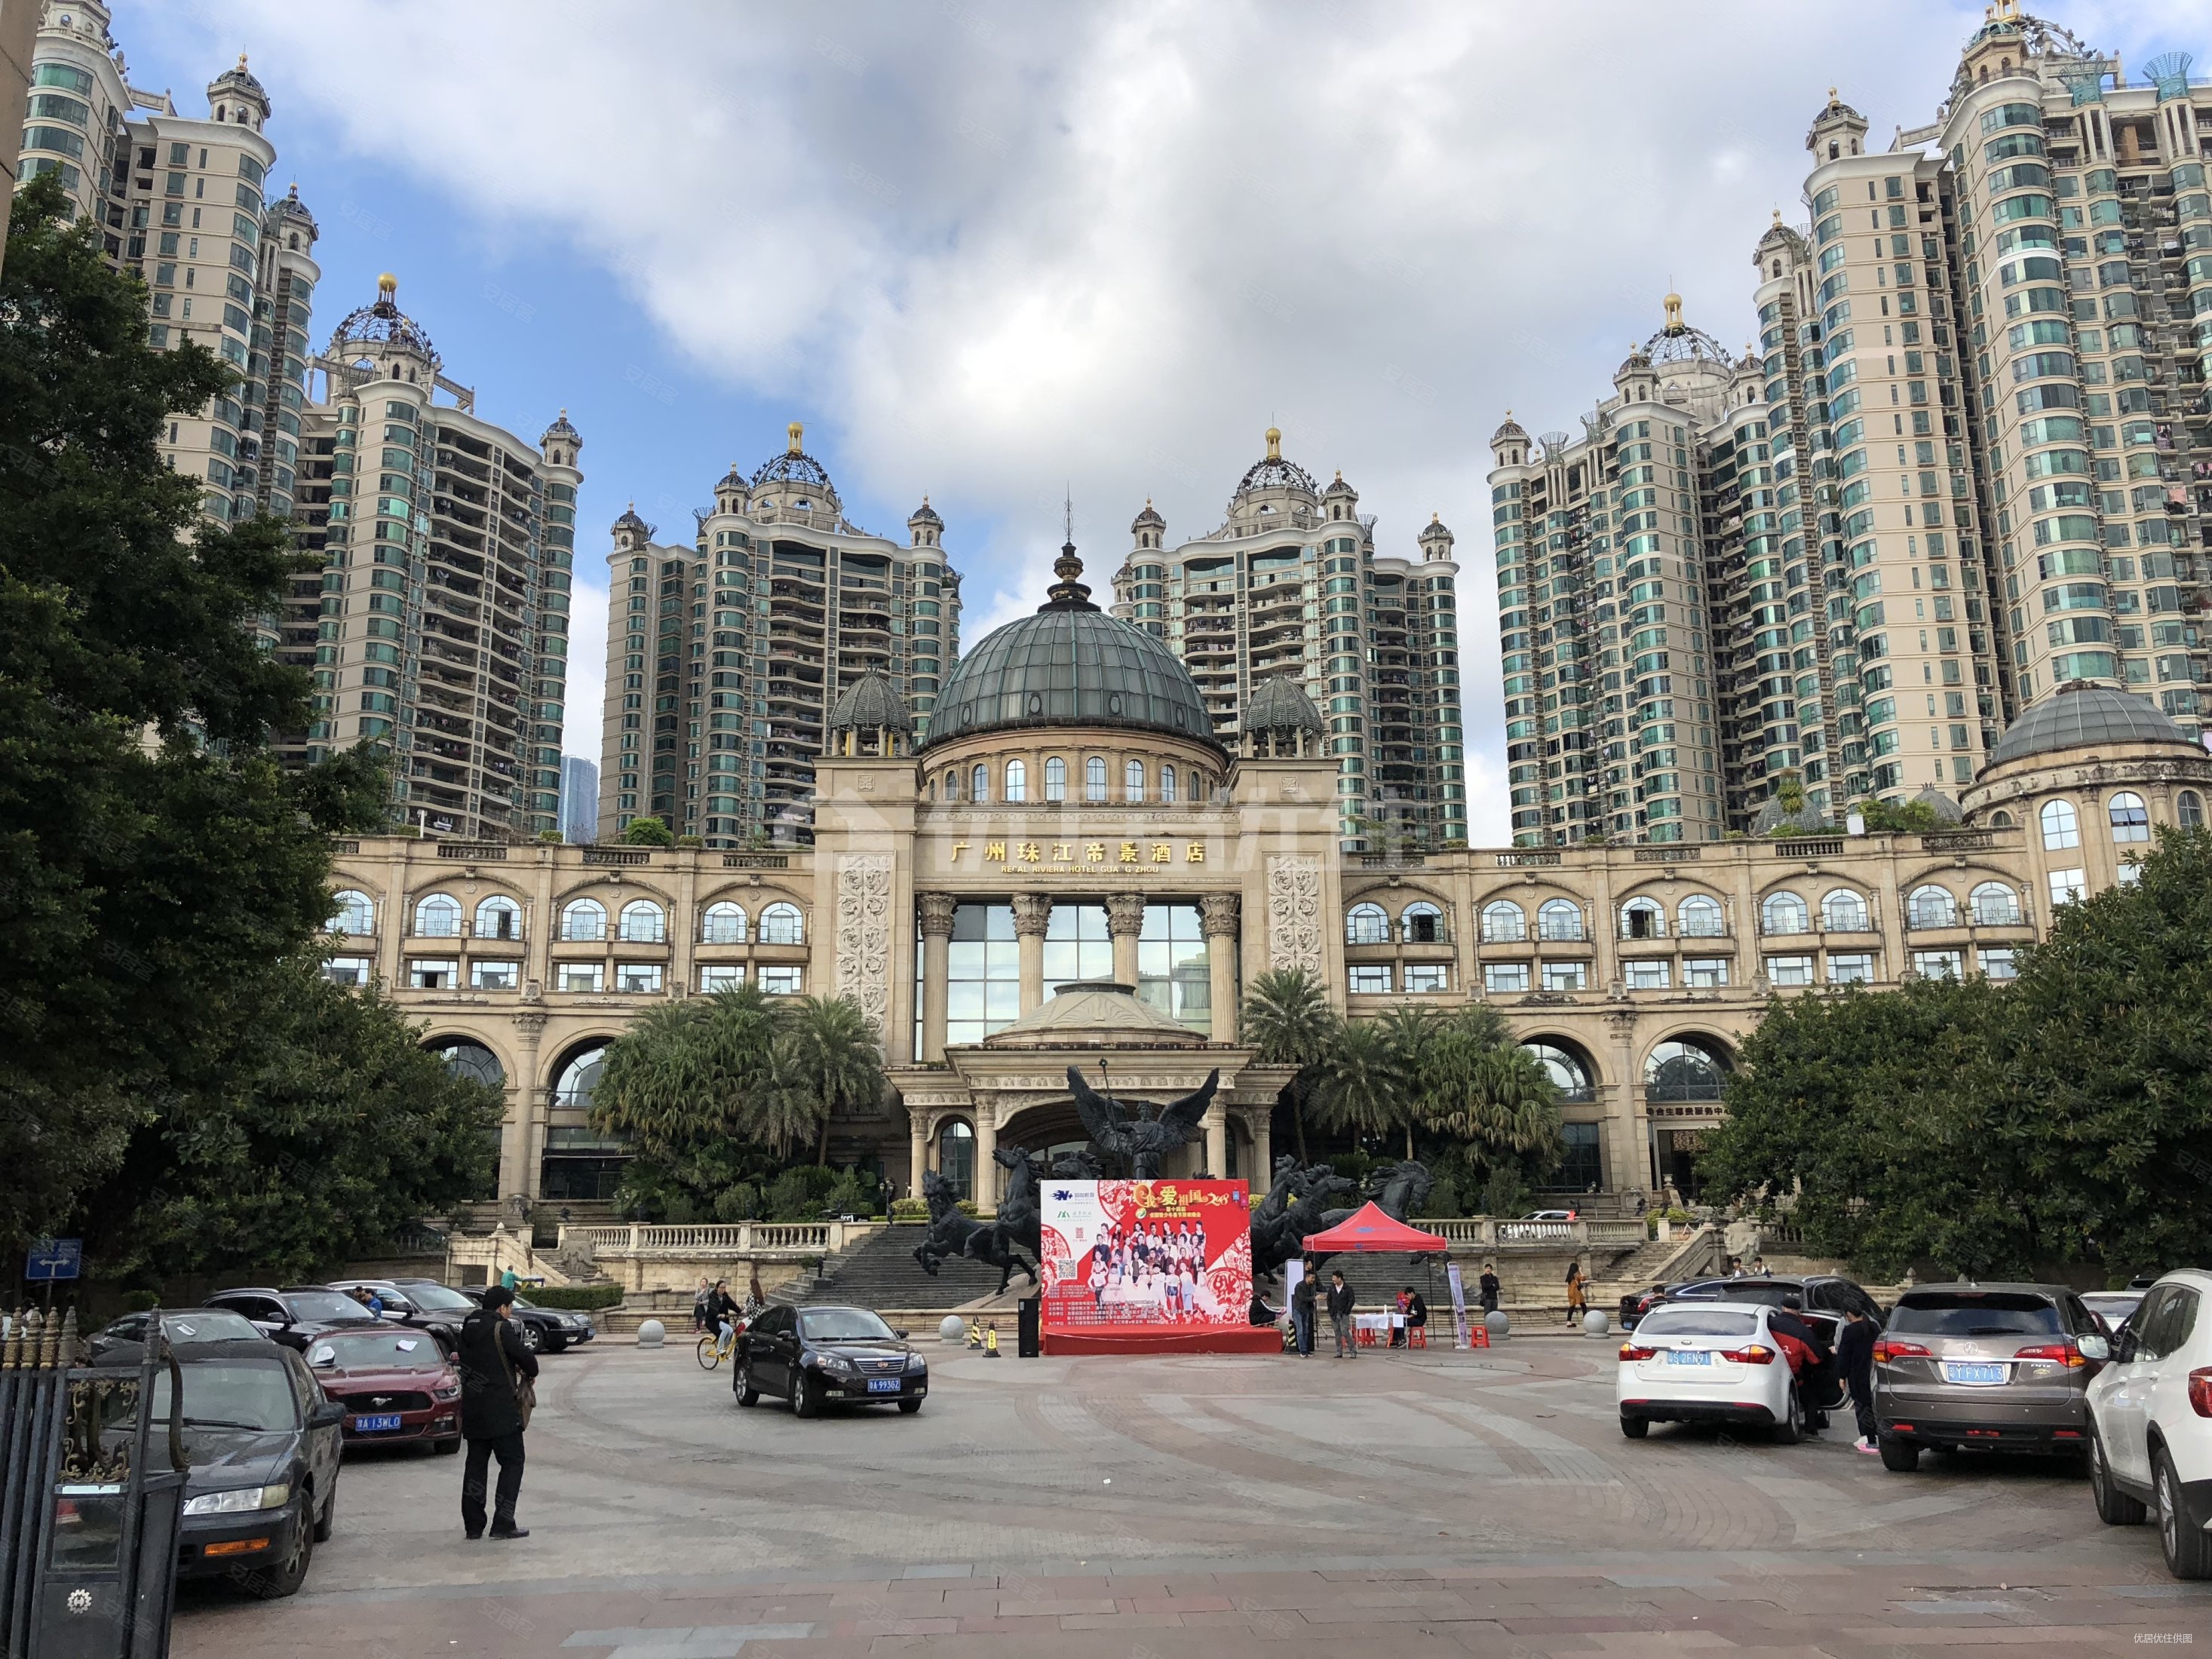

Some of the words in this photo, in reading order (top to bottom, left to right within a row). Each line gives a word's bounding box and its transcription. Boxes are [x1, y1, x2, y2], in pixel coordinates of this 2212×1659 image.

[950, 841, 1205, 862] 广州珠江帝景酒店
[1069, 865, 1096, 873] HOTEL
[1100, 865, 1131, 873] GUAG
[1135, 865, 1159, 873] ZHOU
